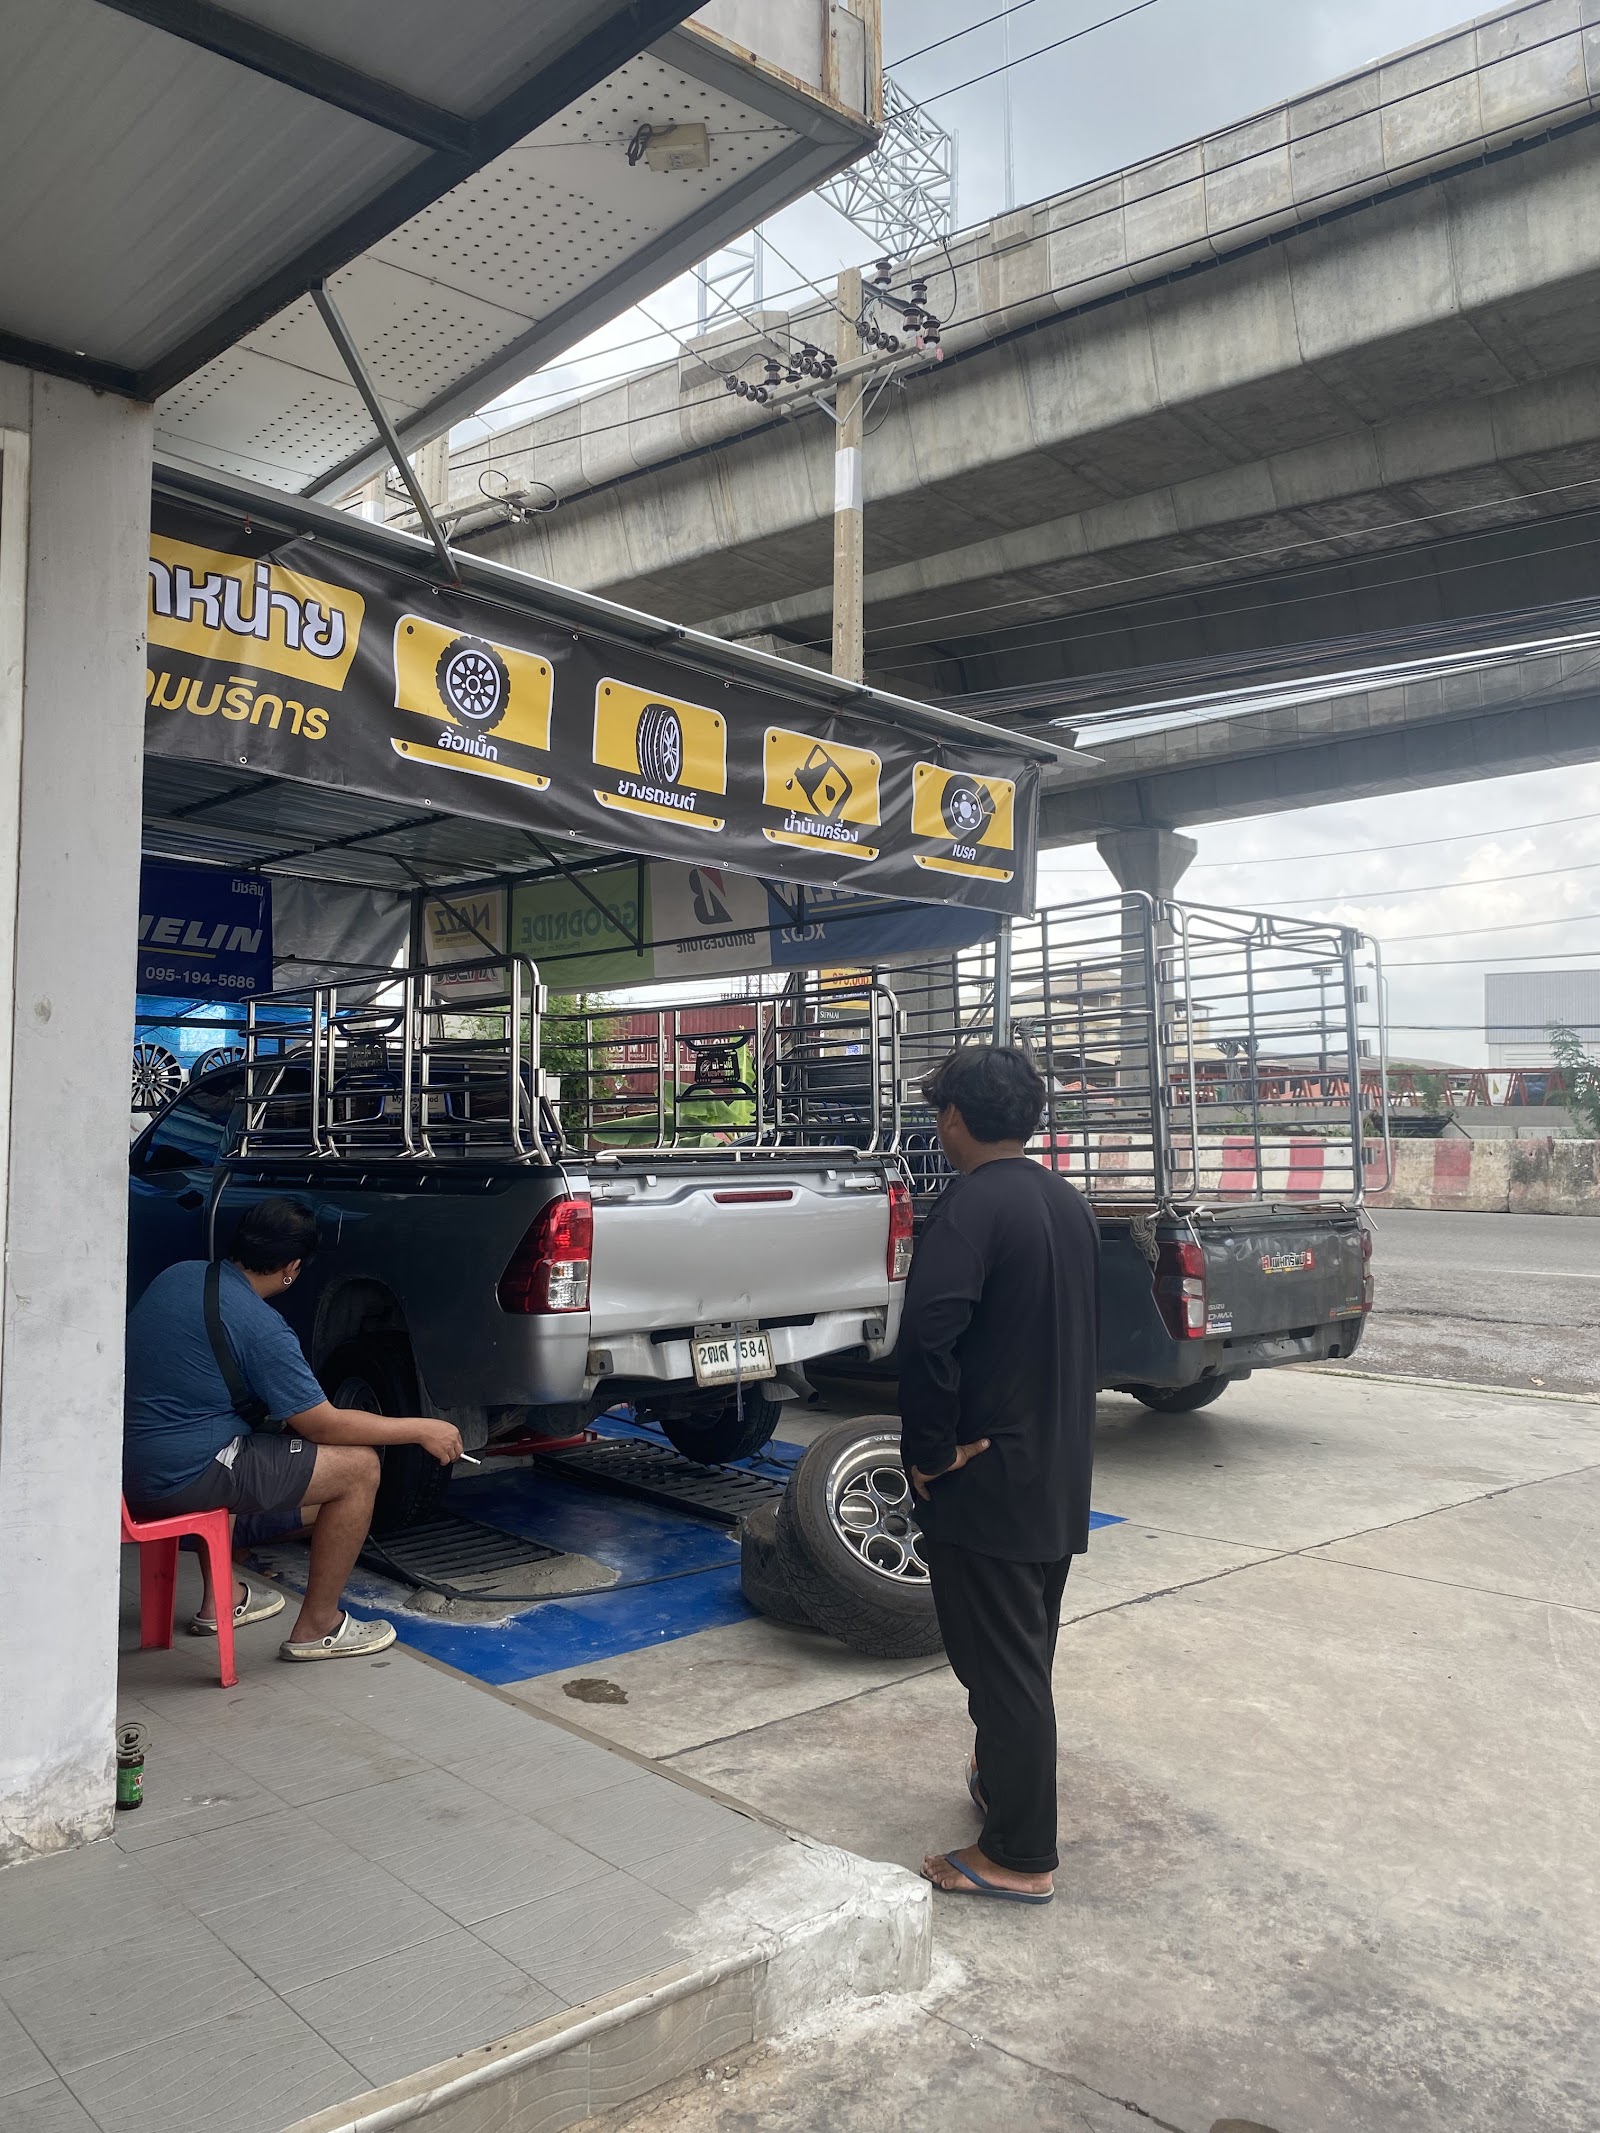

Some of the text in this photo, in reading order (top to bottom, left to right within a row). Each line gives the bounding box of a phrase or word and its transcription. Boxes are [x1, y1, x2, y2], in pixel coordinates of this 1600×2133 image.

[438, 726, 498, 761] ล้อแม็ก
[618, 780, 697, 811] ยางรถยนต์
[784, 810, 859, 842] น้ำมันเครื่อง
[145, 967, 256, 989] 095-194-5686
[873, 1434, 902, 1442] WEL
